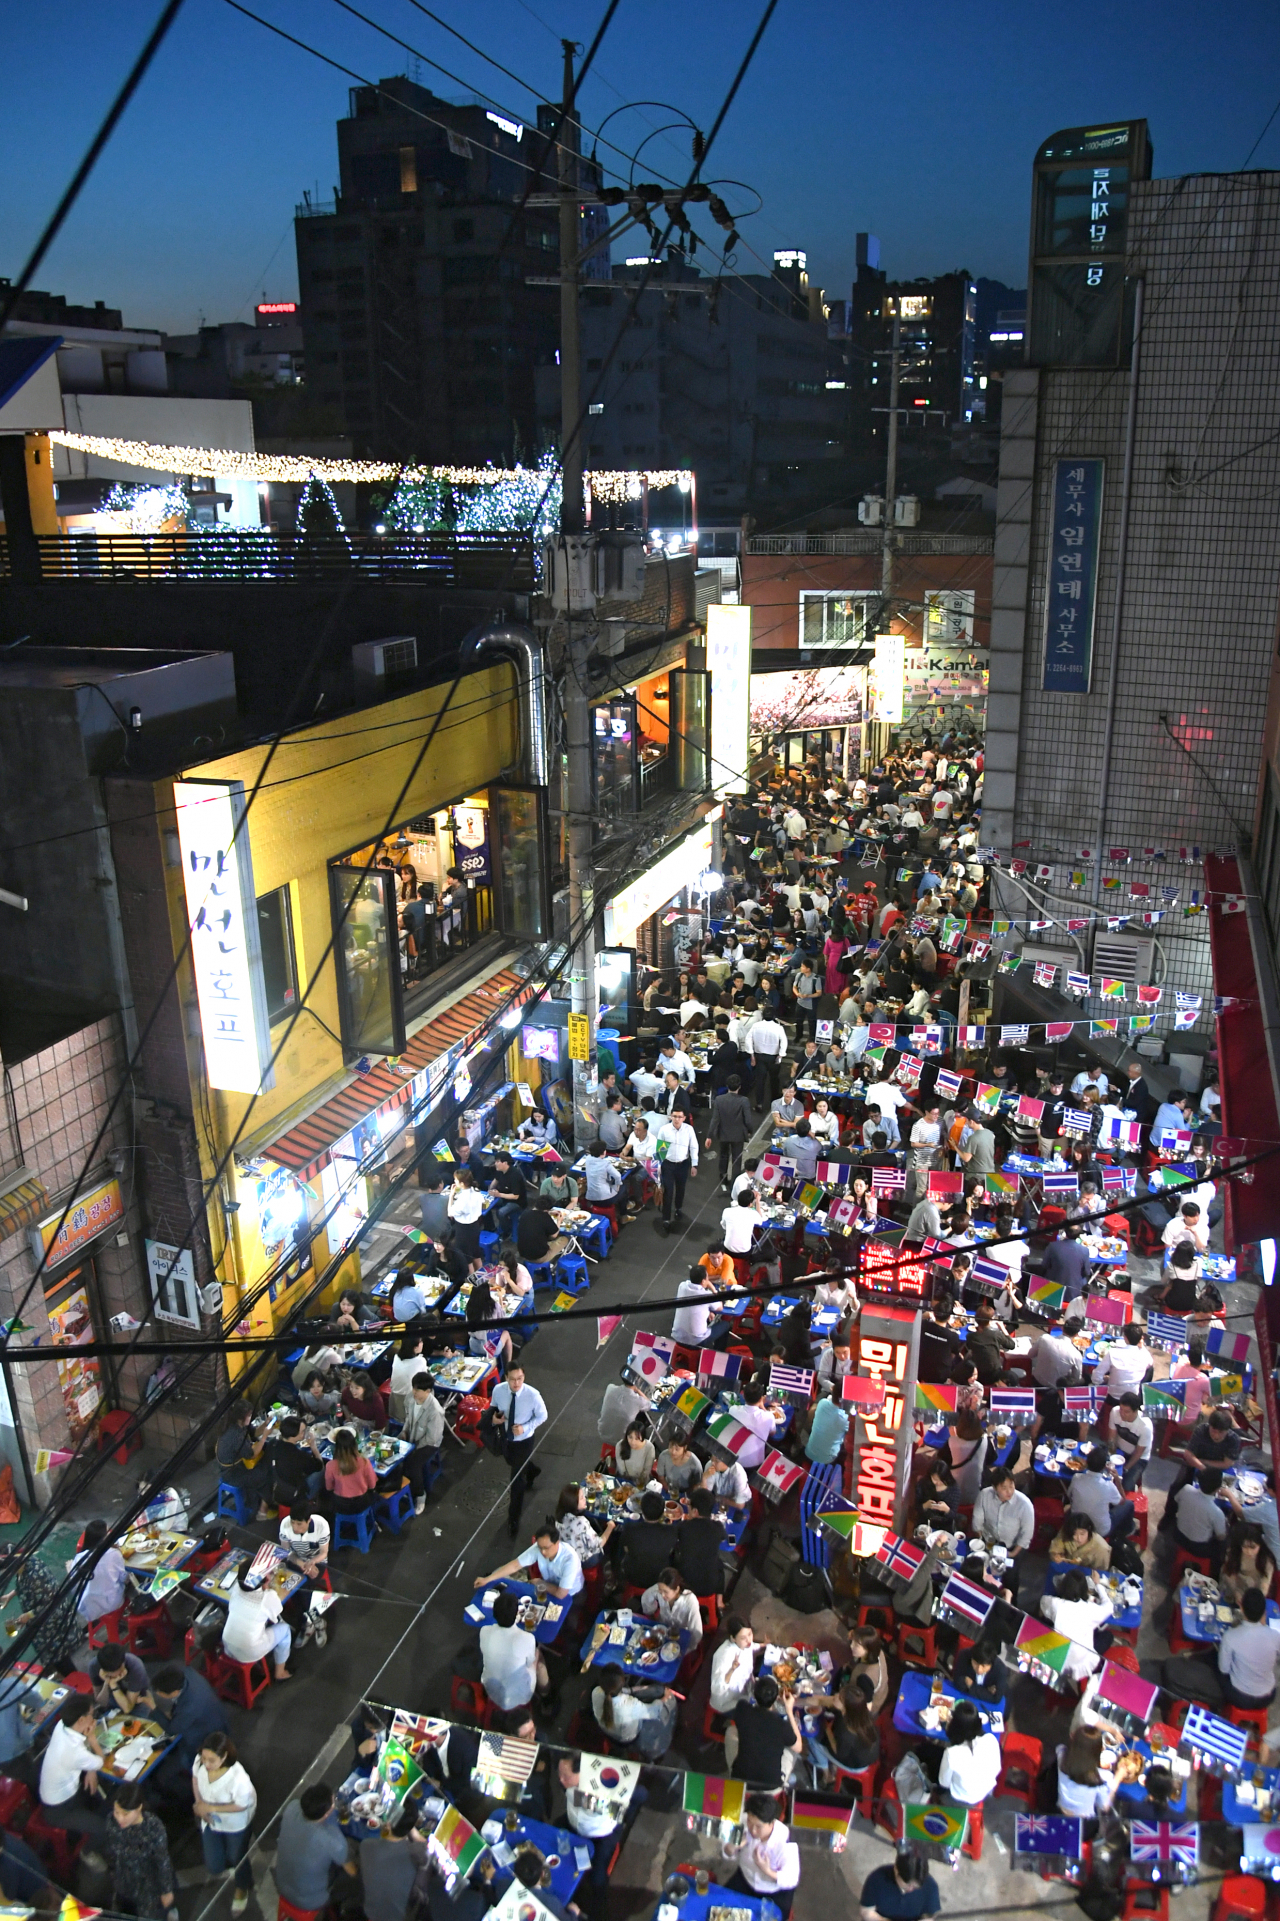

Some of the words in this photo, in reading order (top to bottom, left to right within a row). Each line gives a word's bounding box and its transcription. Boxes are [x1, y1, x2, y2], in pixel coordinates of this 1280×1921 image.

[1065, 467, 1086, 517] 세무사
[1057, 526, 1085, 600] 임연태
[1055, 607, 1078, 654] 사무소
[190, 849, 245, 1042] 만선호프
[89, 1195, 112, 1219] 광장
